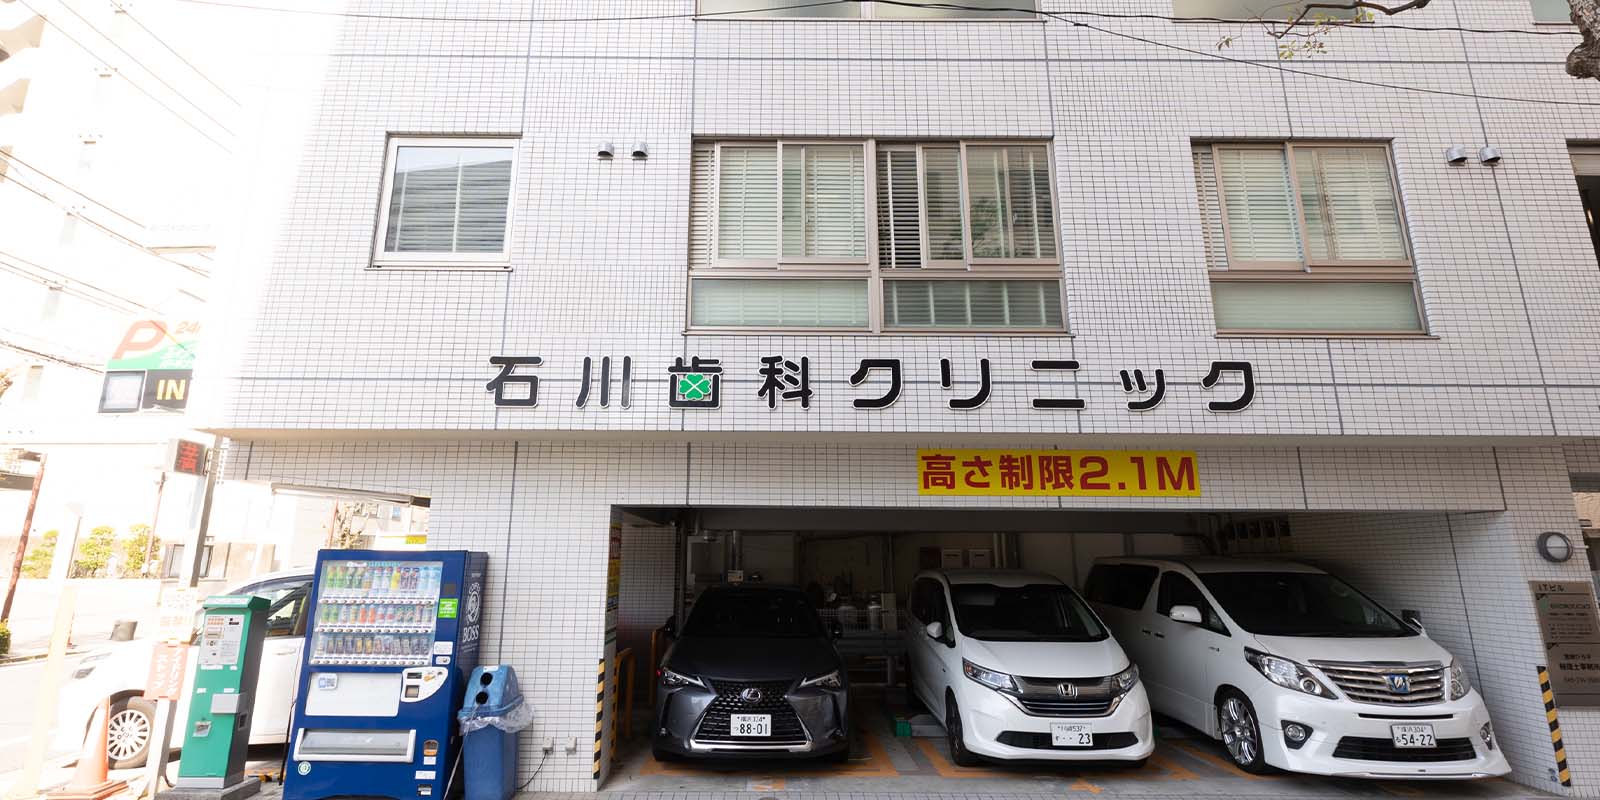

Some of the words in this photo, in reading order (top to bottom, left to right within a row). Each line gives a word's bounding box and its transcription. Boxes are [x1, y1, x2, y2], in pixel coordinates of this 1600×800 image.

[111, 320, 168, 360] P
[156, 379, 186, 400] IN
[485, 355, 1256, 413] 石川歯科クリニック
[921, 454, 1196, 491] 高さ制限2.1M
[463, 625, 480, 642] BOSS
